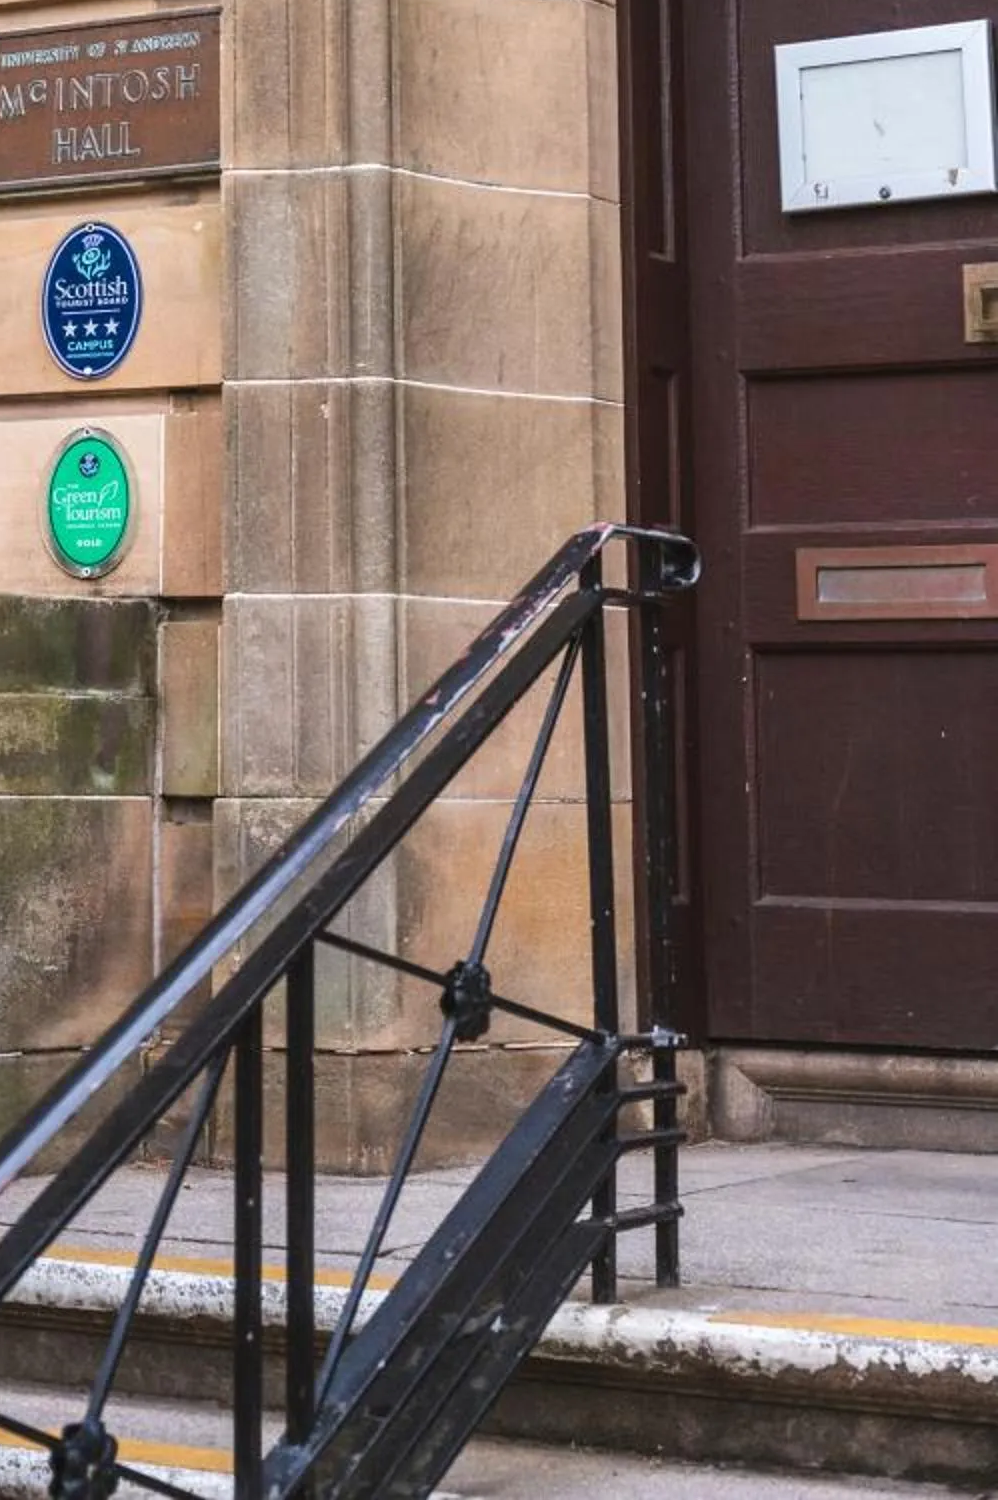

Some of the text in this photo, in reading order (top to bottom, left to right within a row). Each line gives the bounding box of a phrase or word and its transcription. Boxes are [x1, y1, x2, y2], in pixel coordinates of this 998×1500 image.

[87, 42, 106, 58] OF
[53, 122, 141, 163] HALL
[55, 276, 128, 299] Scottish
[67, 340, 113, 351] CAMPUS
[53, 487, 97, 504] Green
[65, 503, 120, 520] Tourism
